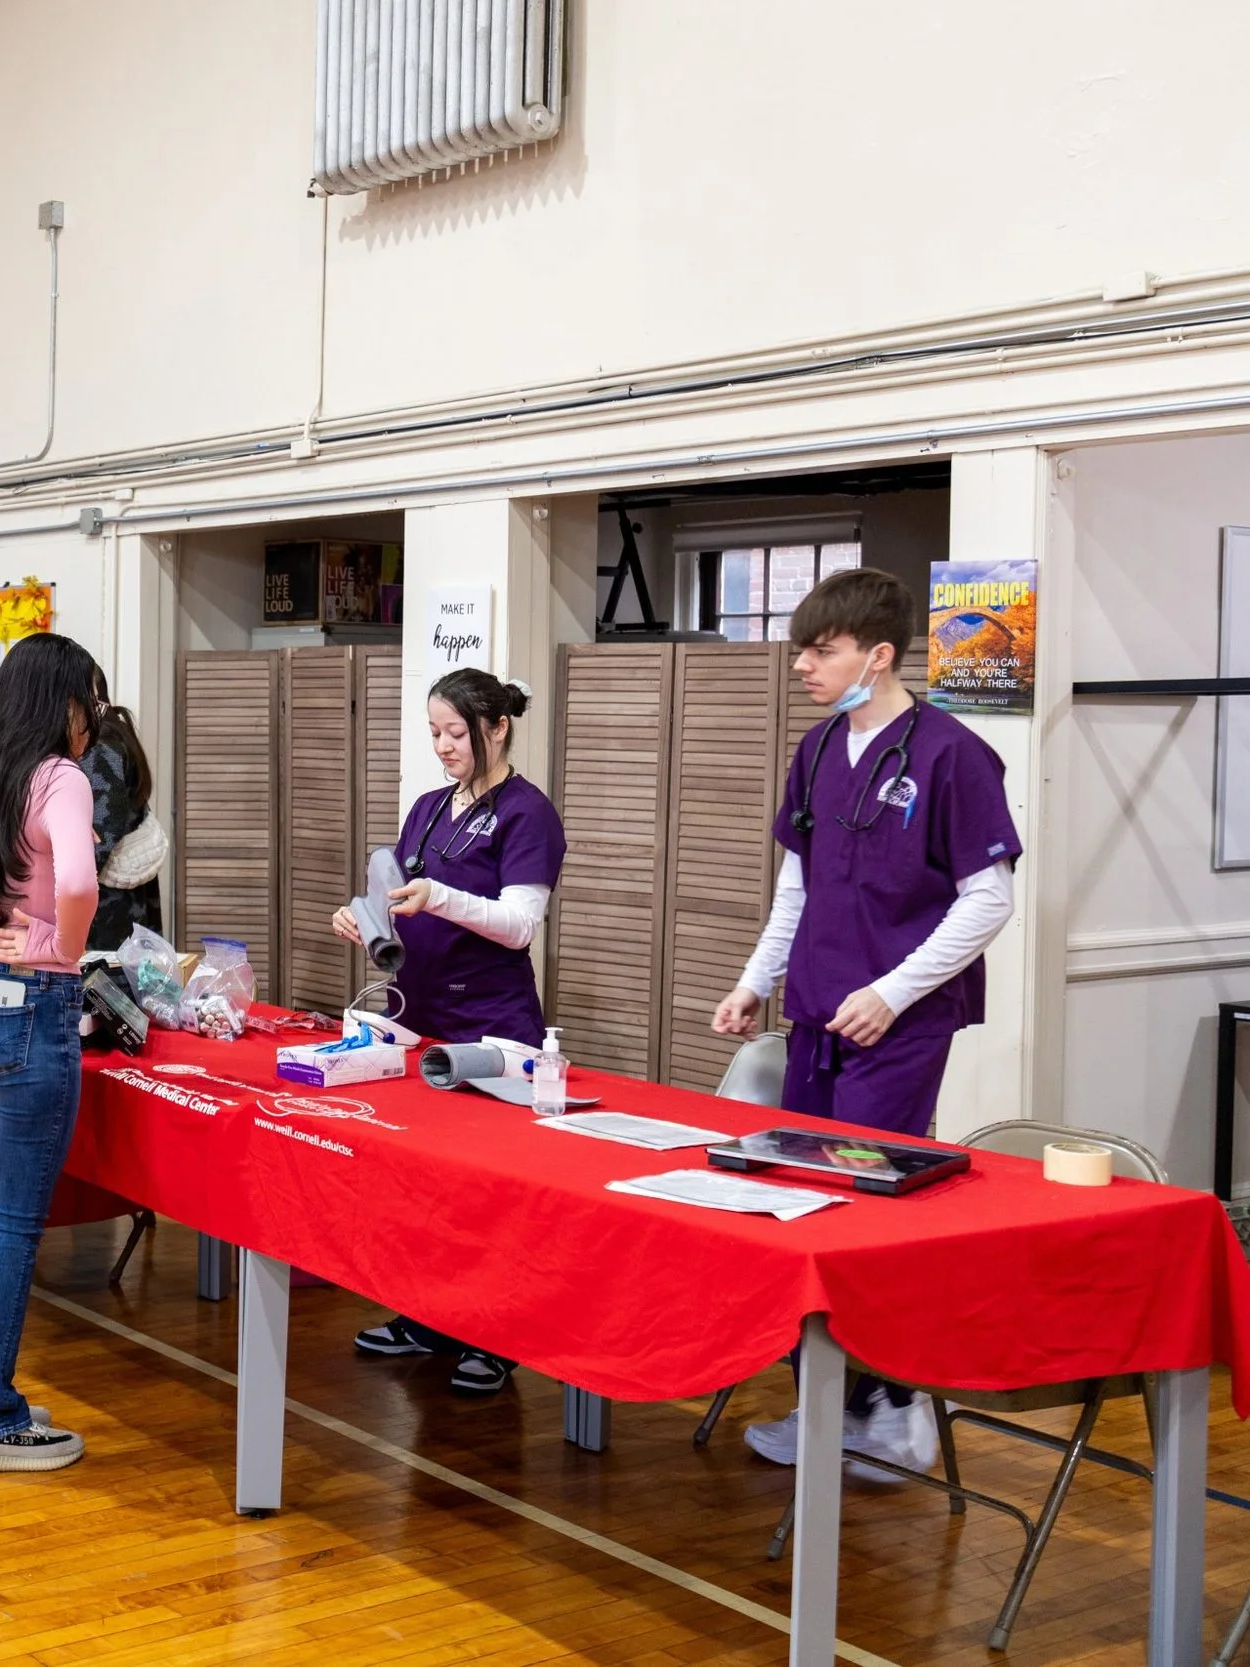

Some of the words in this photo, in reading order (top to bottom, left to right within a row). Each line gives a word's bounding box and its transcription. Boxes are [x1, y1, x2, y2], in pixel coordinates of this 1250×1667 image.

[327, 565, 355, 580] LIVE
[266, 574, 289, 587] LIVE
[266, 587, 289, 599] LIFE
[327, 581, 355, 594] LIFE
[933, 582, 1030, 607] CONFIDENCE
[265, 600, 294, 613] LOUD
[334, 596, 359, 610] OUD
[440, 603, 465, 615] MAKE
[467, 603, 475, 615] IT
[433, 623, 484, 662] happen
[939, 657, 976, 667] BELIEVE
[980, 658, 999, 667] YOU
[1000, 658, 1020, 667] CAN
[950, 668, 970, 677] AND
[974, 668, 1008, 678] YOU'RE
[940, 678, 983, 688] HALFWAY
[986, 679, 1018, 688] THERE
[123, 1074, 156, 1093] Cornell
[154, 1084, 192, 1107] Medical
[189, 1097, 221, 1116] Center
[254, 1116, 354, 1158] www.weill.cornell.edu/ctsc
